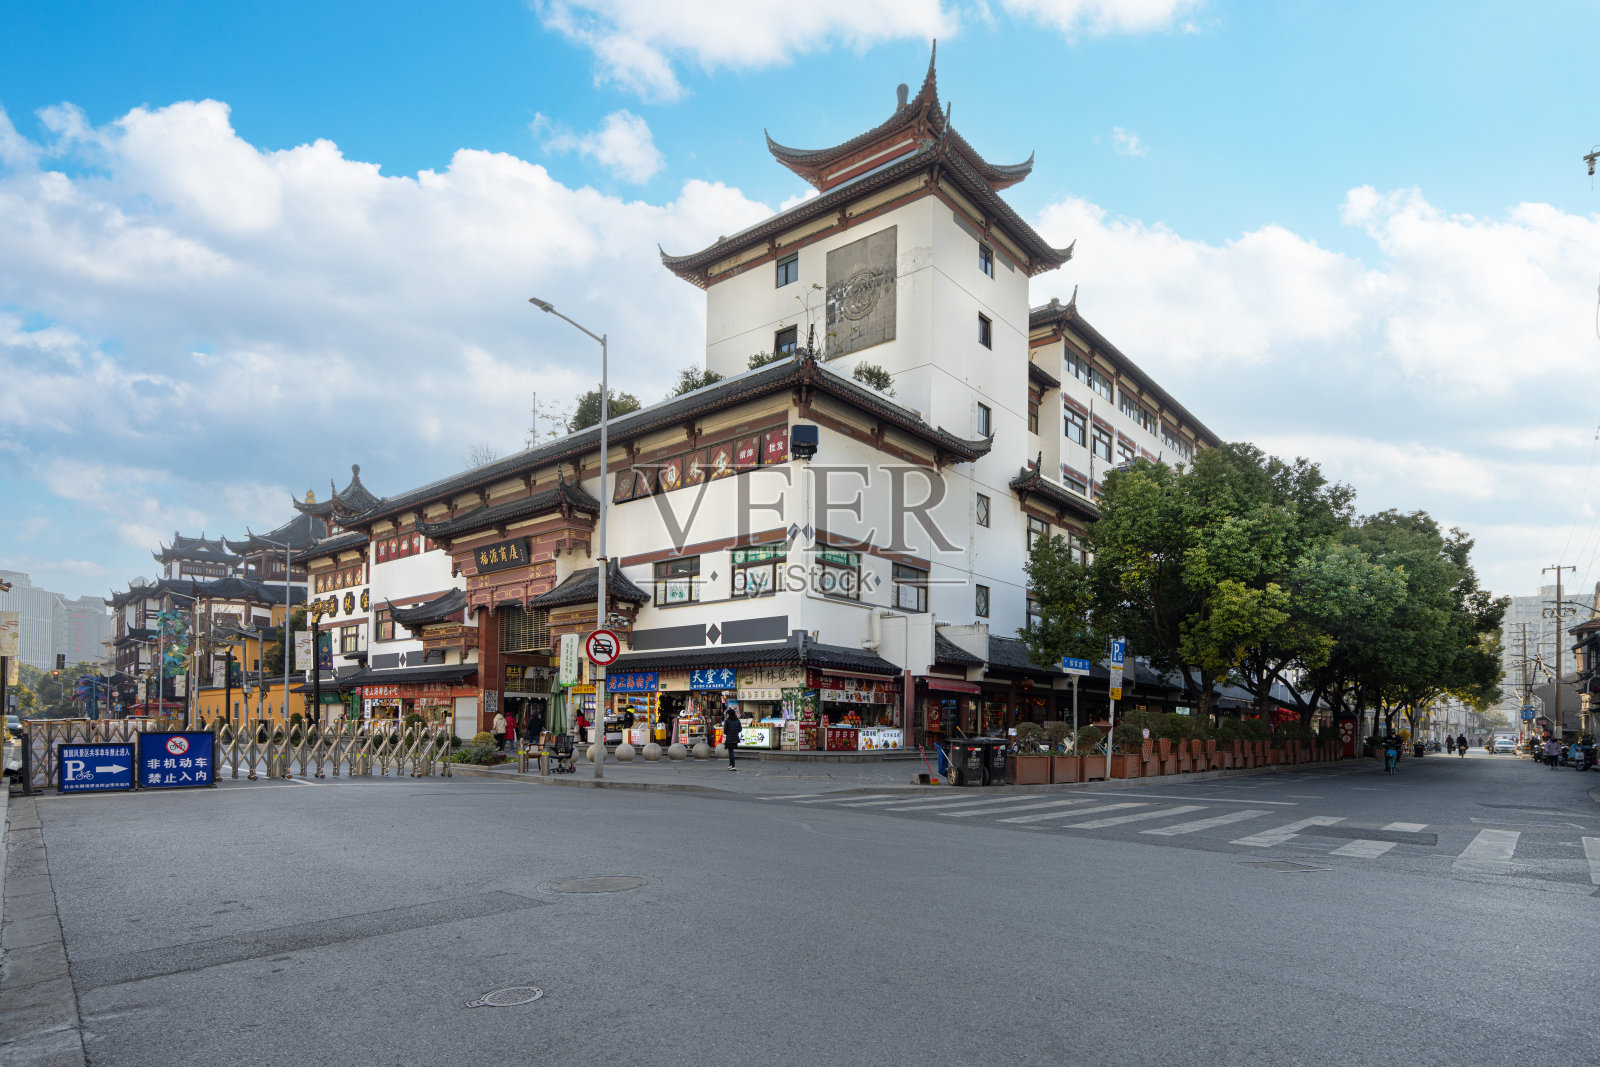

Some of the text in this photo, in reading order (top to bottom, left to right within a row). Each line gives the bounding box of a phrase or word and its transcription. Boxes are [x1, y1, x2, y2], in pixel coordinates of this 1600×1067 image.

[1113, 643, 1120, 661] P
[608, 675, 654, 690] 老上海特产
[692, 668, 734, 684] 天堂伞
[64, 760, 84, 781] P
[147, 758, 208, 769] 非机动车
[148, 771, 207, 784] 禁止入内
